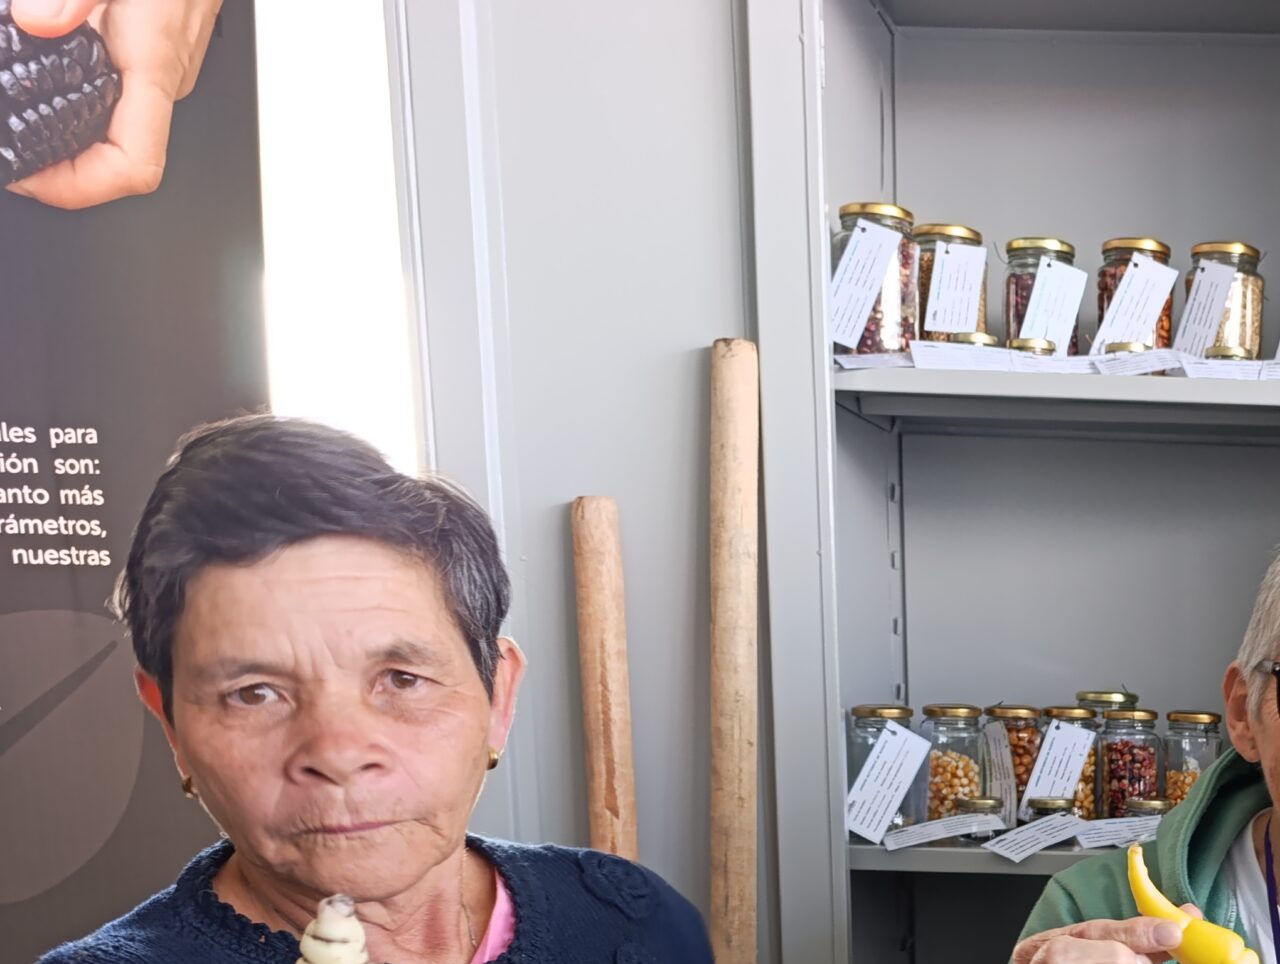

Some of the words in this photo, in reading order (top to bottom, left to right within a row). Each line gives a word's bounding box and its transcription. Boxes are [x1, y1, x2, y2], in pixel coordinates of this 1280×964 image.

[0, 421, 37, 443] les
[49, 427, 98, 448] para
[54, 458, 101, 475] son:
[59, 484, 105, 506] más
[12, 546, 112, 566] nuestras
